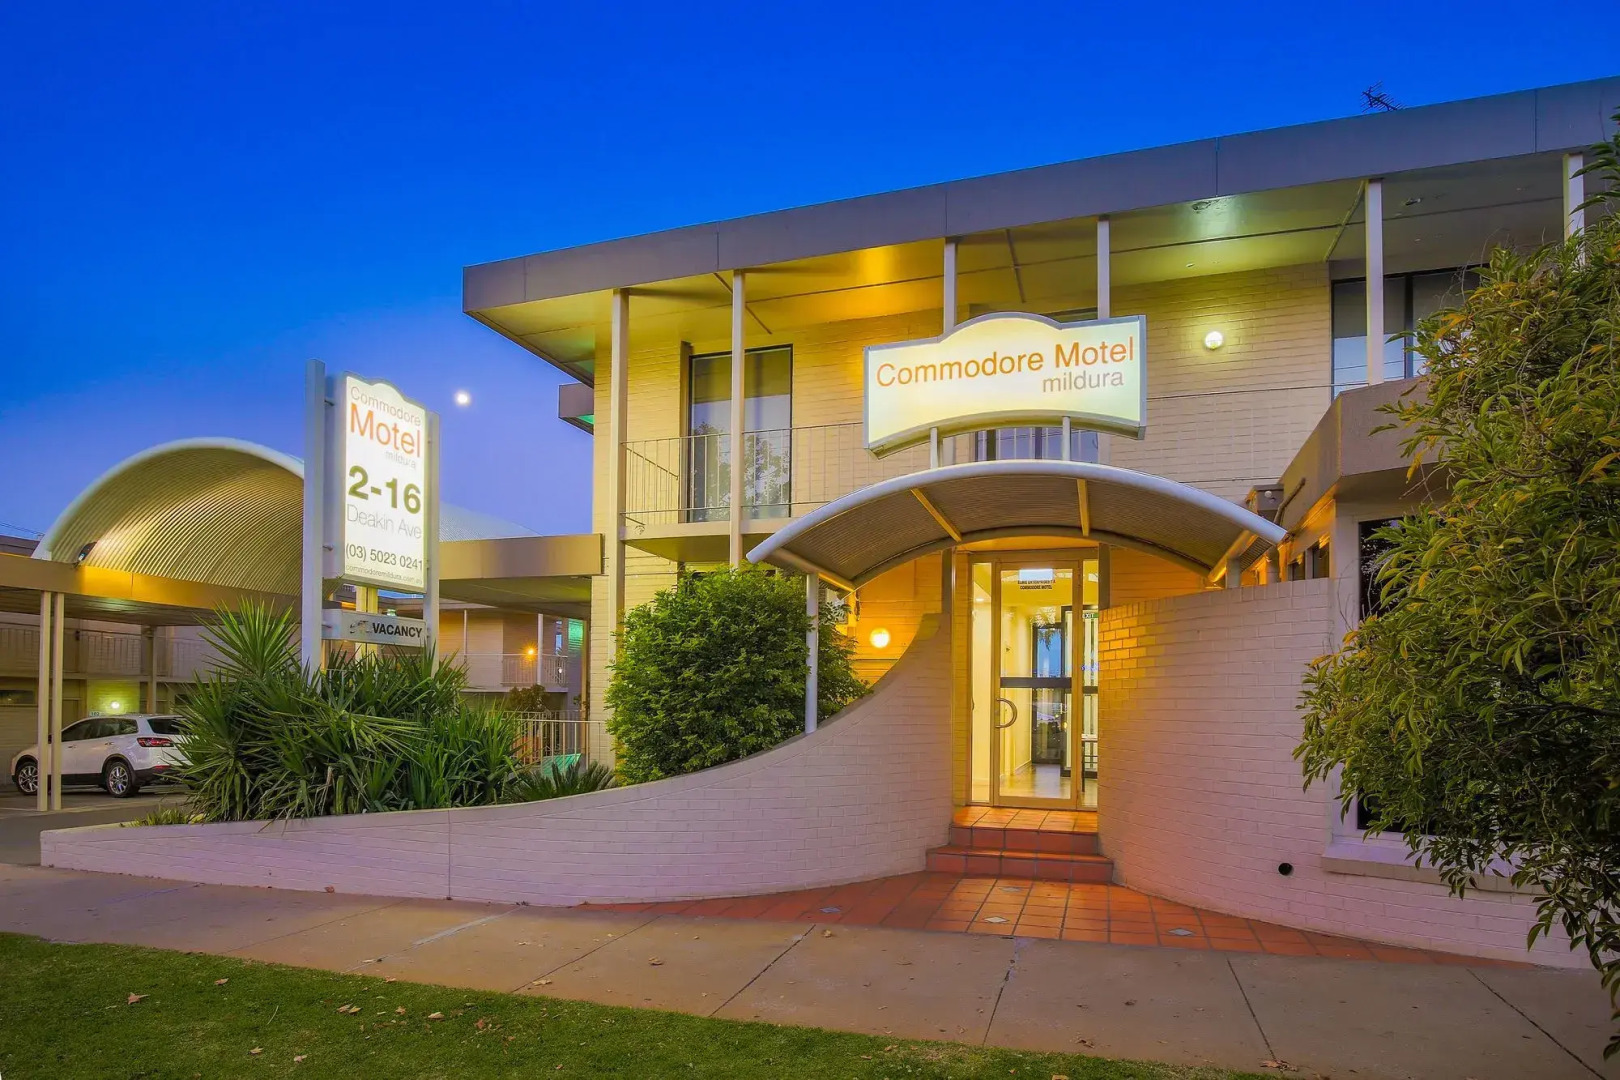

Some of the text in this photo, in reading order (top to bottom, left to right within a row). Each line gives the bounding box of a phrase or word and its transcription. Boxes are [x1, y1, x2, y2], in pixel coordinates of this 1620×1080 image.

[876, 336, 1134, 387] Commodore Motel
[1042, 370, 1124, 393] mildura
[351, 386, 421, 426] Commodore
[351, 402, 420, 458] Motel
[348, 465, 421, 515] 2-16
[347, 503, 422, 539] Deakin Ave
[345, 543, 423, 572] (03) 5023 0241
[372, 622, 422, 638] VACANCY
